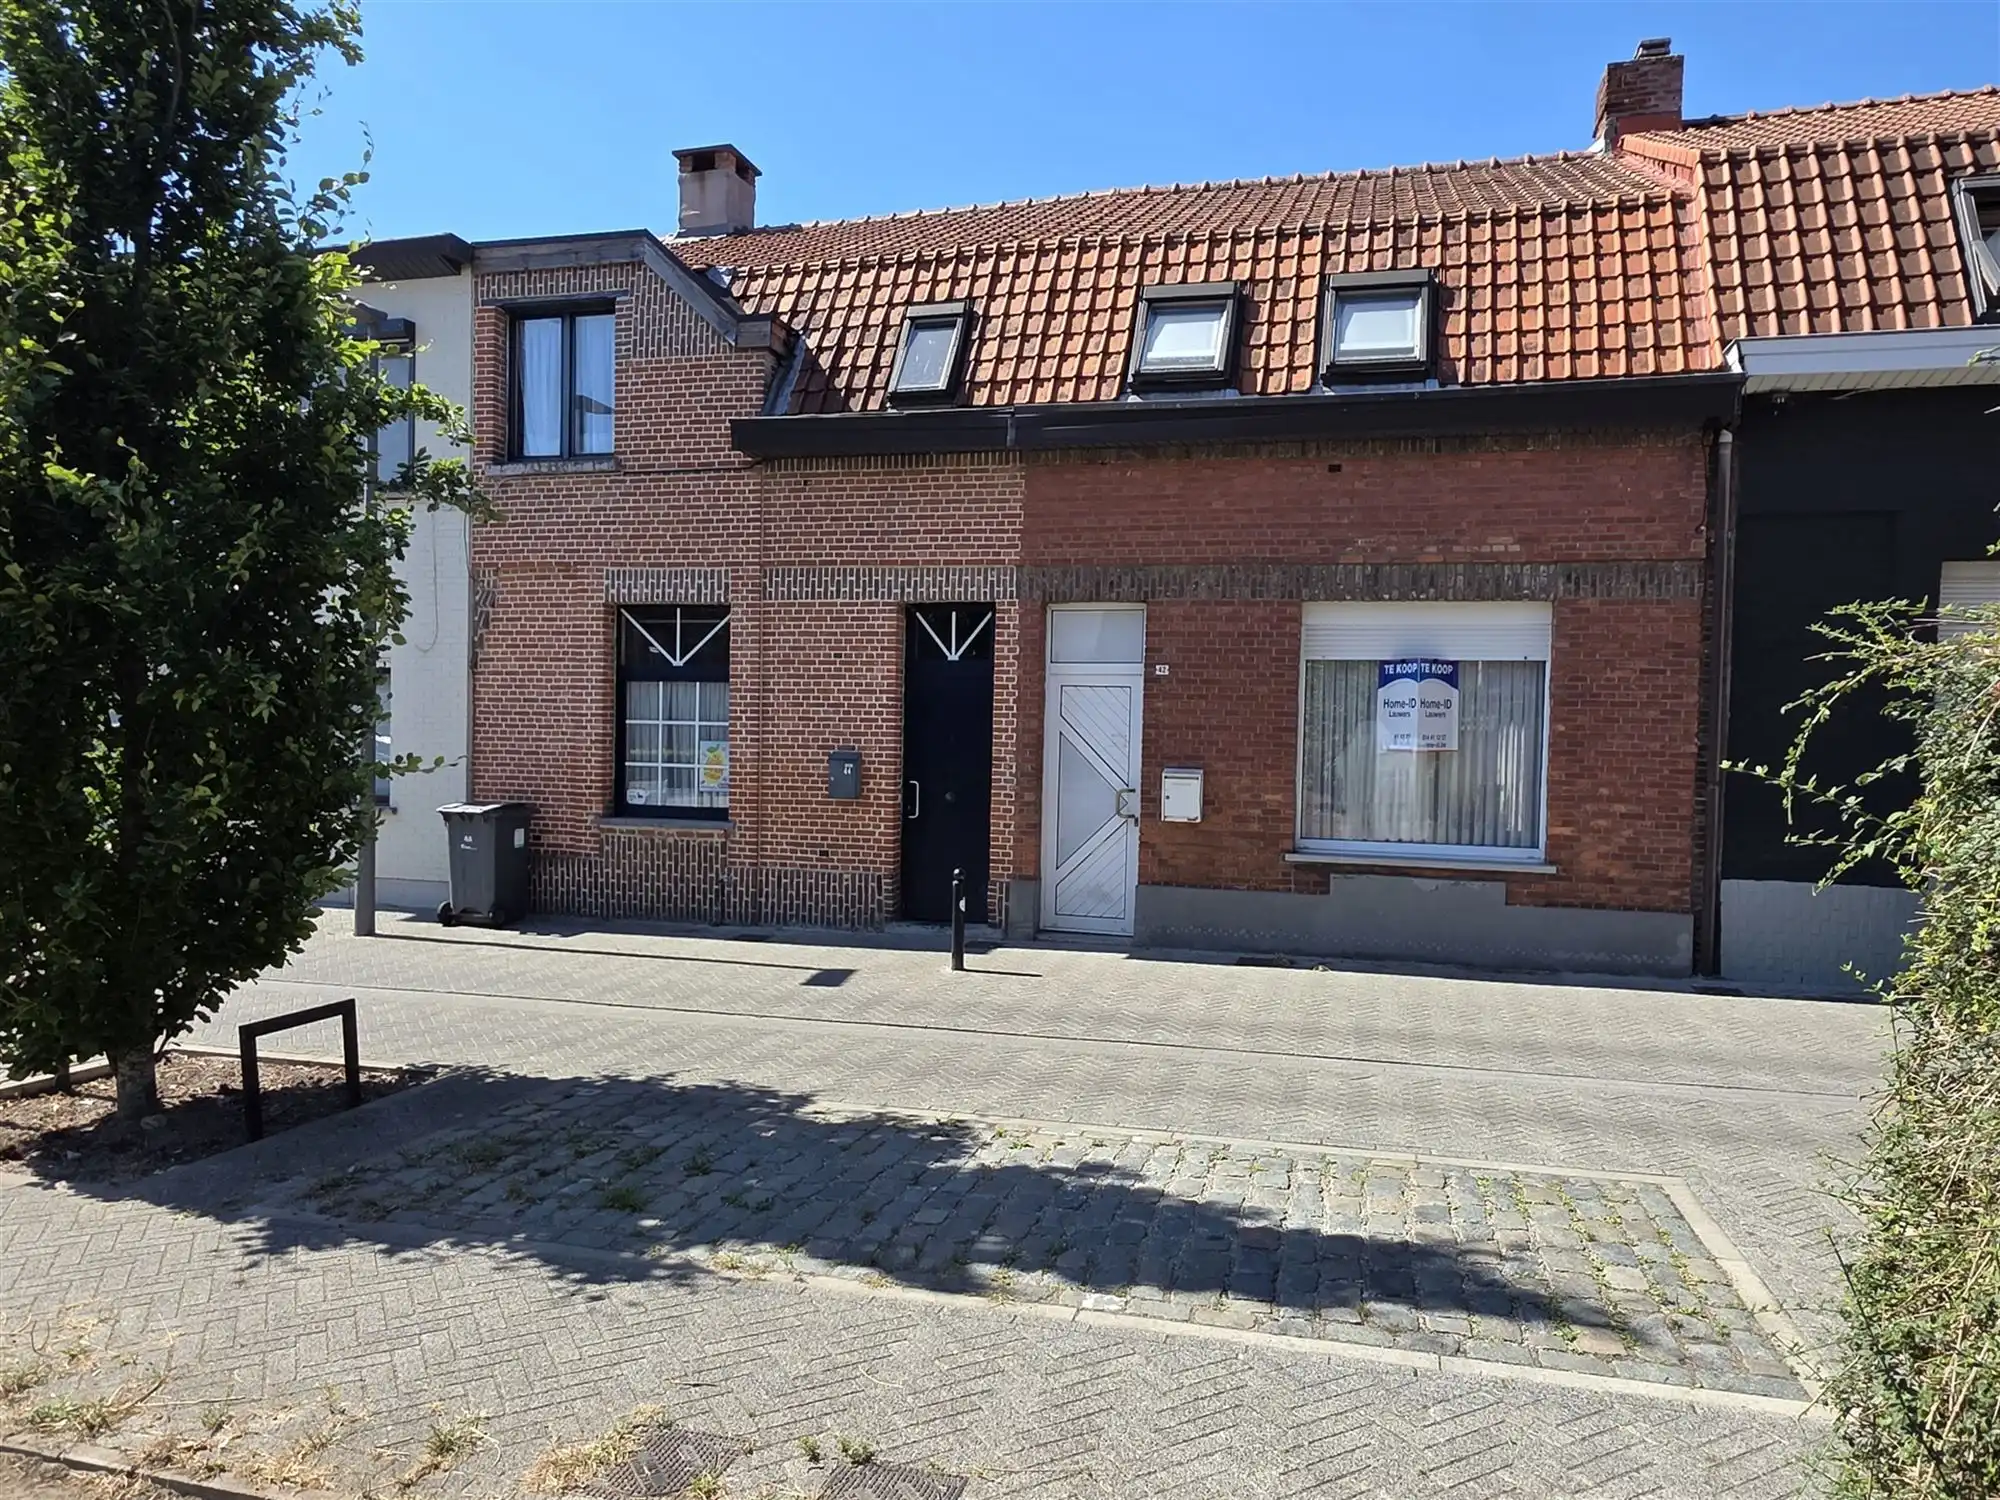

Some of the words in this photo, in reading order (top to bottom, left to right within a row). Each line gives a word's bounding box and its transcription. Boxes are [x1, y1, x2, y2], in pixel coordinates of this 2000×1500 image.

[1384, 664, 1395, 675] TE
[1396, 663, 1418, 674] KOOP
[1420, 663, 1430, 673] TE
[1431, 664, 1454, 675] KOOP
[1383, 698, 1417, 709] Home-ID
[1420, 698, 1452, 709] Home-ID
